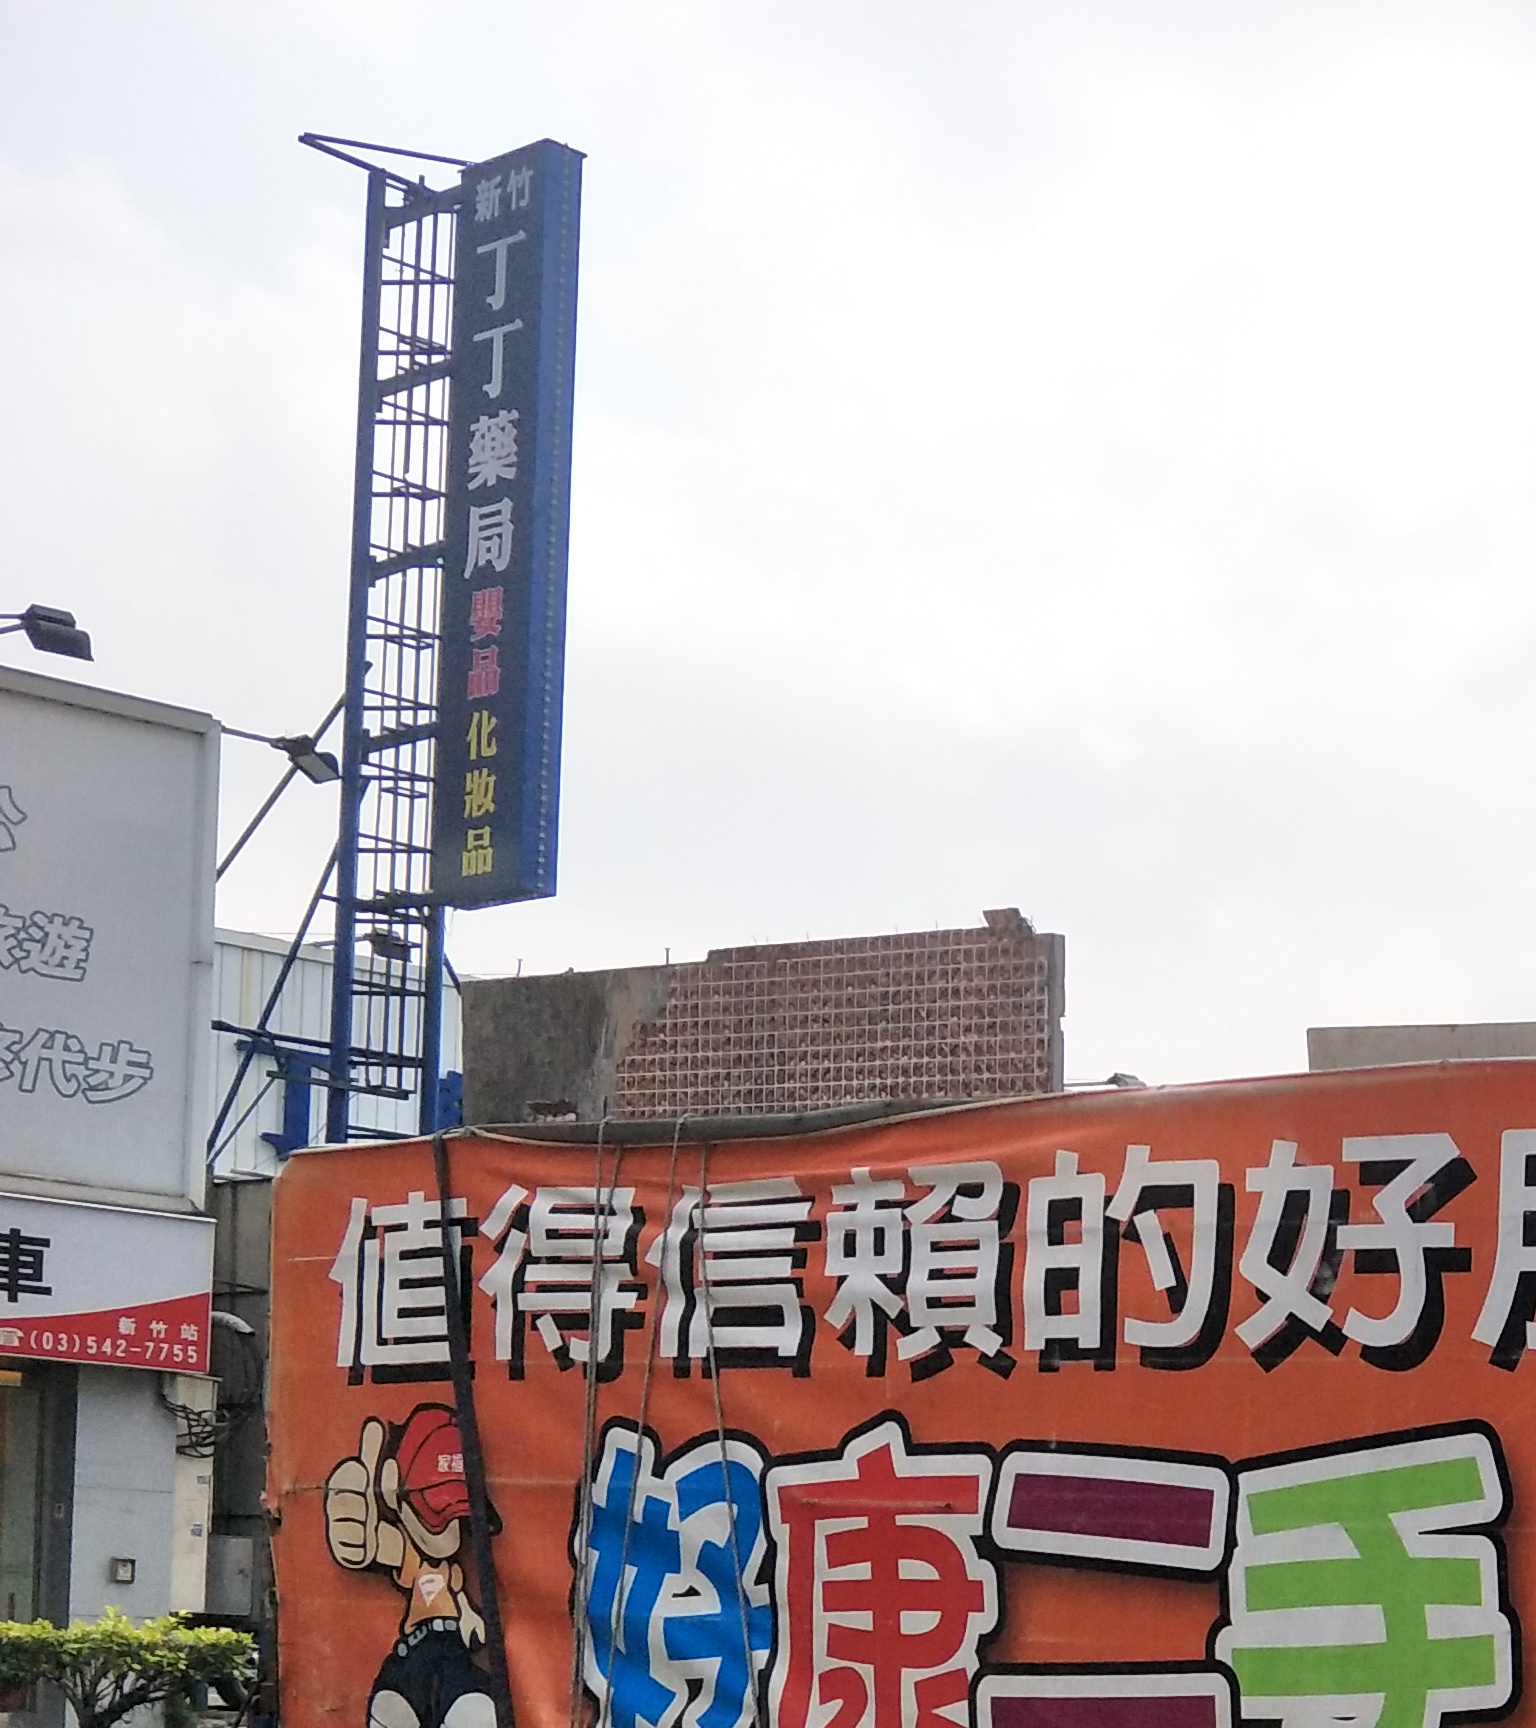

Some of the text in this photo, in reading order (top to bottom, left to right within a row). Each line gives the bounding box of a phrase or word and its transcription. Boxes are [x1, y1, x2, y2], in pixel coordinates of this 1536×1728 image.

[475, 164, 534, 223] 新竹
[463, 229, 526, 580] 丁丁藥局
[29, 1329, 198, 1364] (03)542-7755
[118, 1315, 199, 1342] 新竹站
